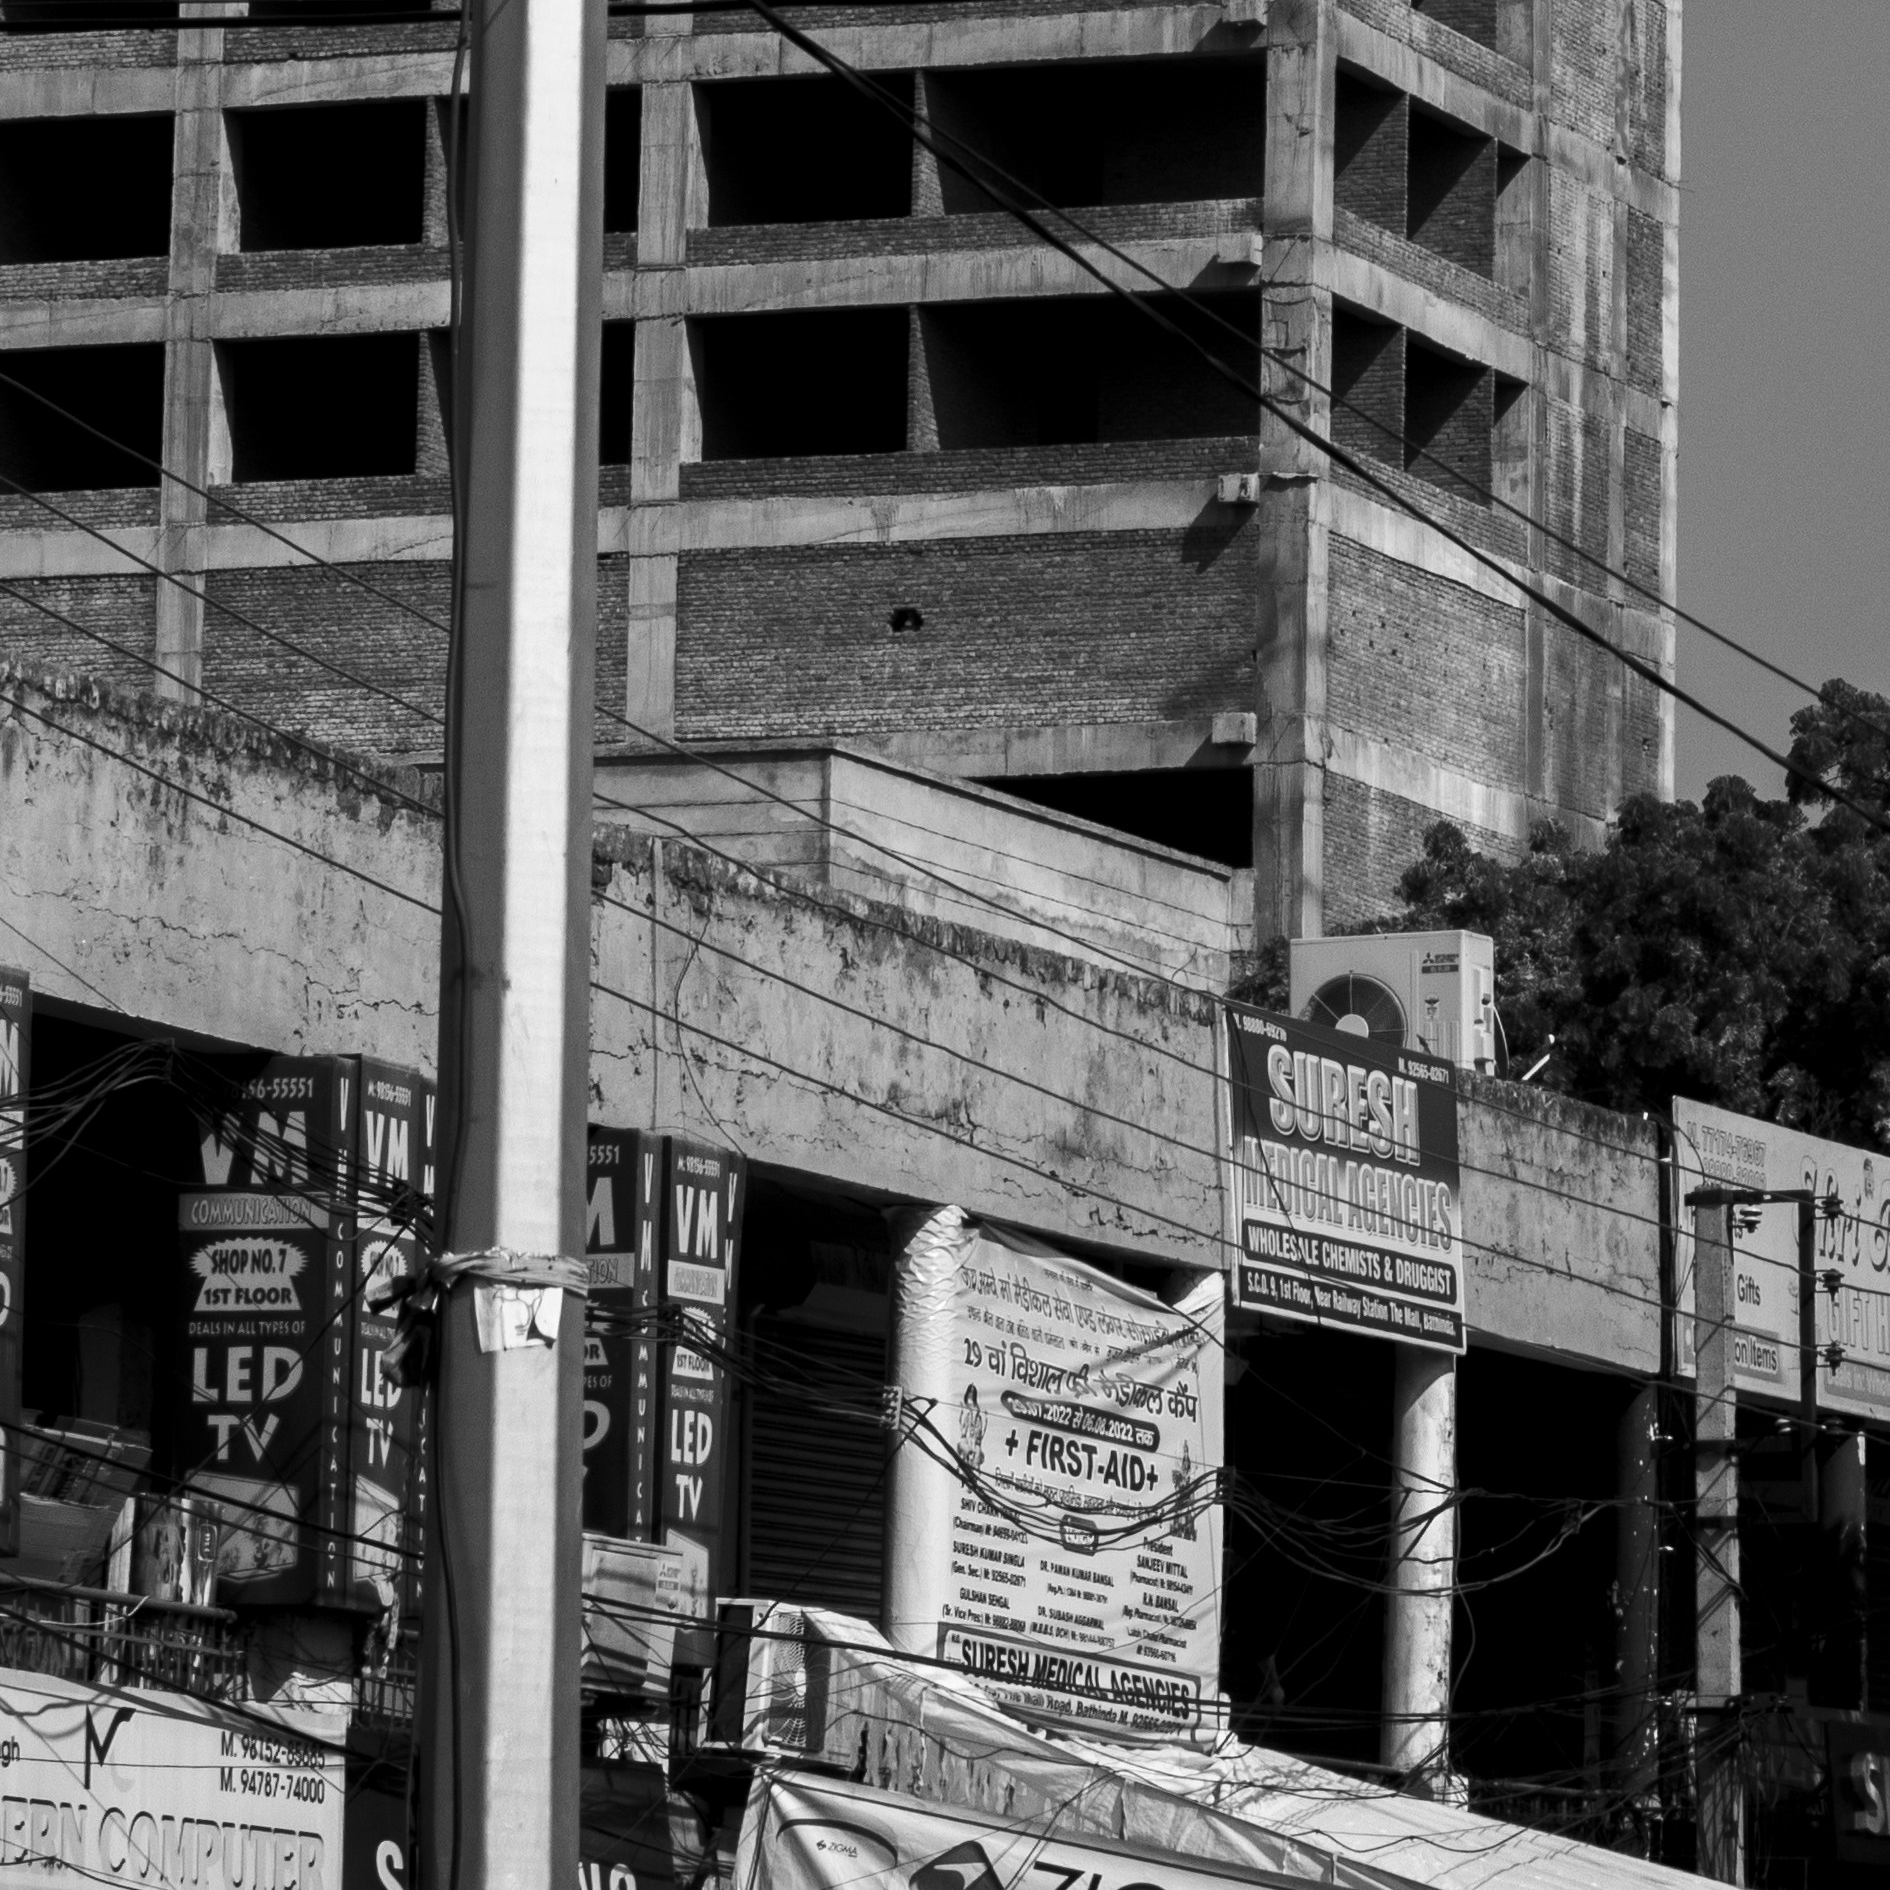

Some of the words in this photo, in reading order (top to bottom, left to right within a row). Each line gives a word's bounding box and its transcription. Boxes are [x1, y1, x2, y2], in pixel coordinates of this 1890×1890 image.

[1267, 1044, 1420, 1167] SURESH
[365, 1110, 409, 1188] VM
[190, 1198, 314, 1226] COMMUNICATION
[1243, 1134, 1343, 1226] MEDICAL
[1345, 1160, 1452, 1252] AGENCIES
[675, 1184, 718, 1260] VM
[211, 1248, 249, 1274] SHOP
[250, 1248, 274, 1274] NO.
[275, 1248, 288, 1274] 7
[1247, 1225, 1320, 1266] WHOLESALE
[1322, 1242, 1381, 1280] CHEMISTS
[1384, 1256, 1393, 1282] &
[1395, 1258, 1452, 1296] DRUGGIST
[204, 1288, 233, 1306] 1ST
[235, 1287, 292, 1306] FLOOR
[1280, 1278, 1291, 1295] 1st
[1333, 1290, 1361, 1319] Railway
[1363, 1296, 1389, 1322] Station
[1390, 1302, 1403, 1324] The
[1737, 1273, 1761, 1306] Gifts
[189, 1321, 221, 1335] DEALS
[223, 1321, 234, 1335] IN
[235, 1321, 256, 1335] ALL
[259, 1321, 290, 1335] TYPES
[291, 1321, 305, 1335] OF
[192, 1346, 303, 1402] LED
[963, 1338, 982, 1367] 29
[1011, 1342, 1067, 1394] विशाल
[1750, 1335, 1778, 1371] Items
[207, 1413, 280, 1462] TV
[366, 1416, 394, 1469] TV
[670, 1408, 713, 1465] LED
[1135, 1427, 1155, 1447] तक
[675, 1473, 703, 1522] TV
[952, 1542, 979, 1557] SURESH
[980, 1548, 1002, 1562] KUMAR
[1164, 1562, 1188, 1577] MITTAL
[961, 1638, 1030, 1682] SURESH
[1034, 1652, 1101, 1696] MEDICAL
[1076, 1700, 1117, 1724] Bathinda
[220, 1767, 237, 1793] M.
[240, 1770, 326, 1804] 94787-74000
[99, 1807, 326, 1890] COMPUTER
[827, 1840, 860, 1859] ZIGMA
